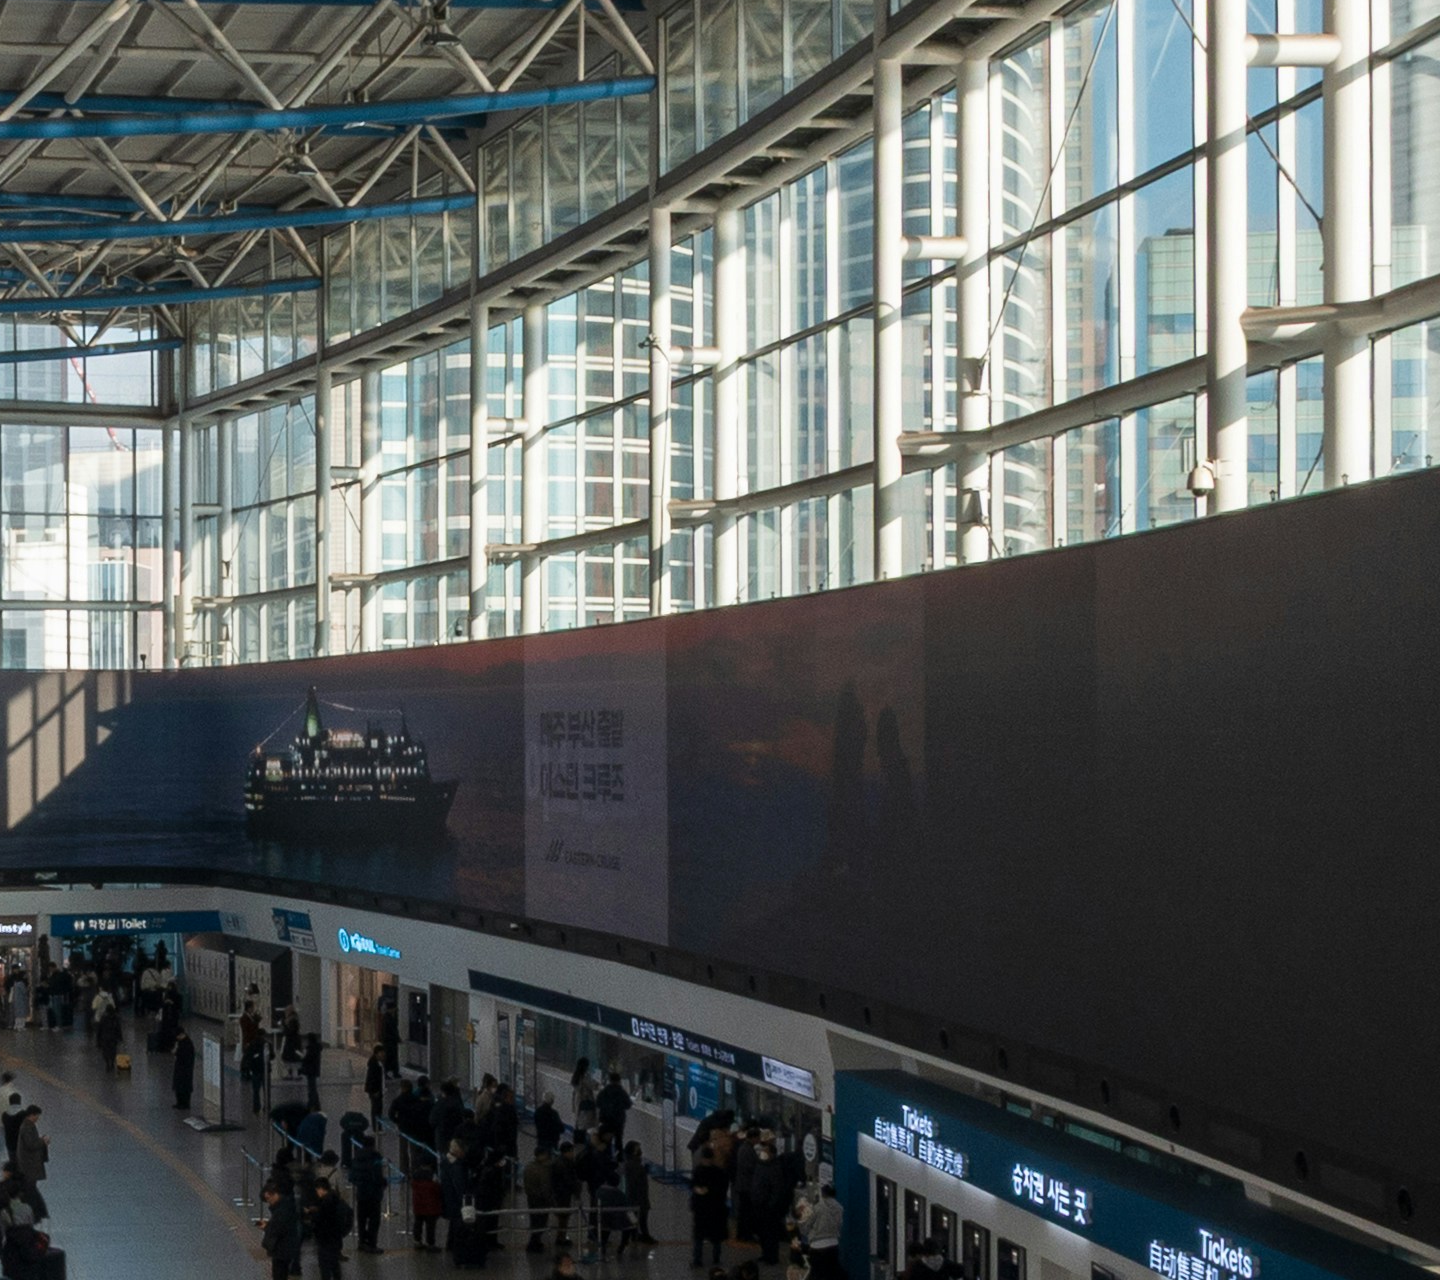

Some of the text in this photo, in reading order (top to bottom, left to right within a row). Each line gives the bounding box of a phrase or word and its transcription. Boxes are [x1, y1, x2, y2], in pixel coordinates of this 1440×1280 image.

[88, 918, 147, 931] 화장실 Toilet
[901, 1103, 934, 1138] Tickets
[1011, 1162, 1087, 1226] 승차권 사는 곳
[1198, 1228, 1253, 1279] Tickets
